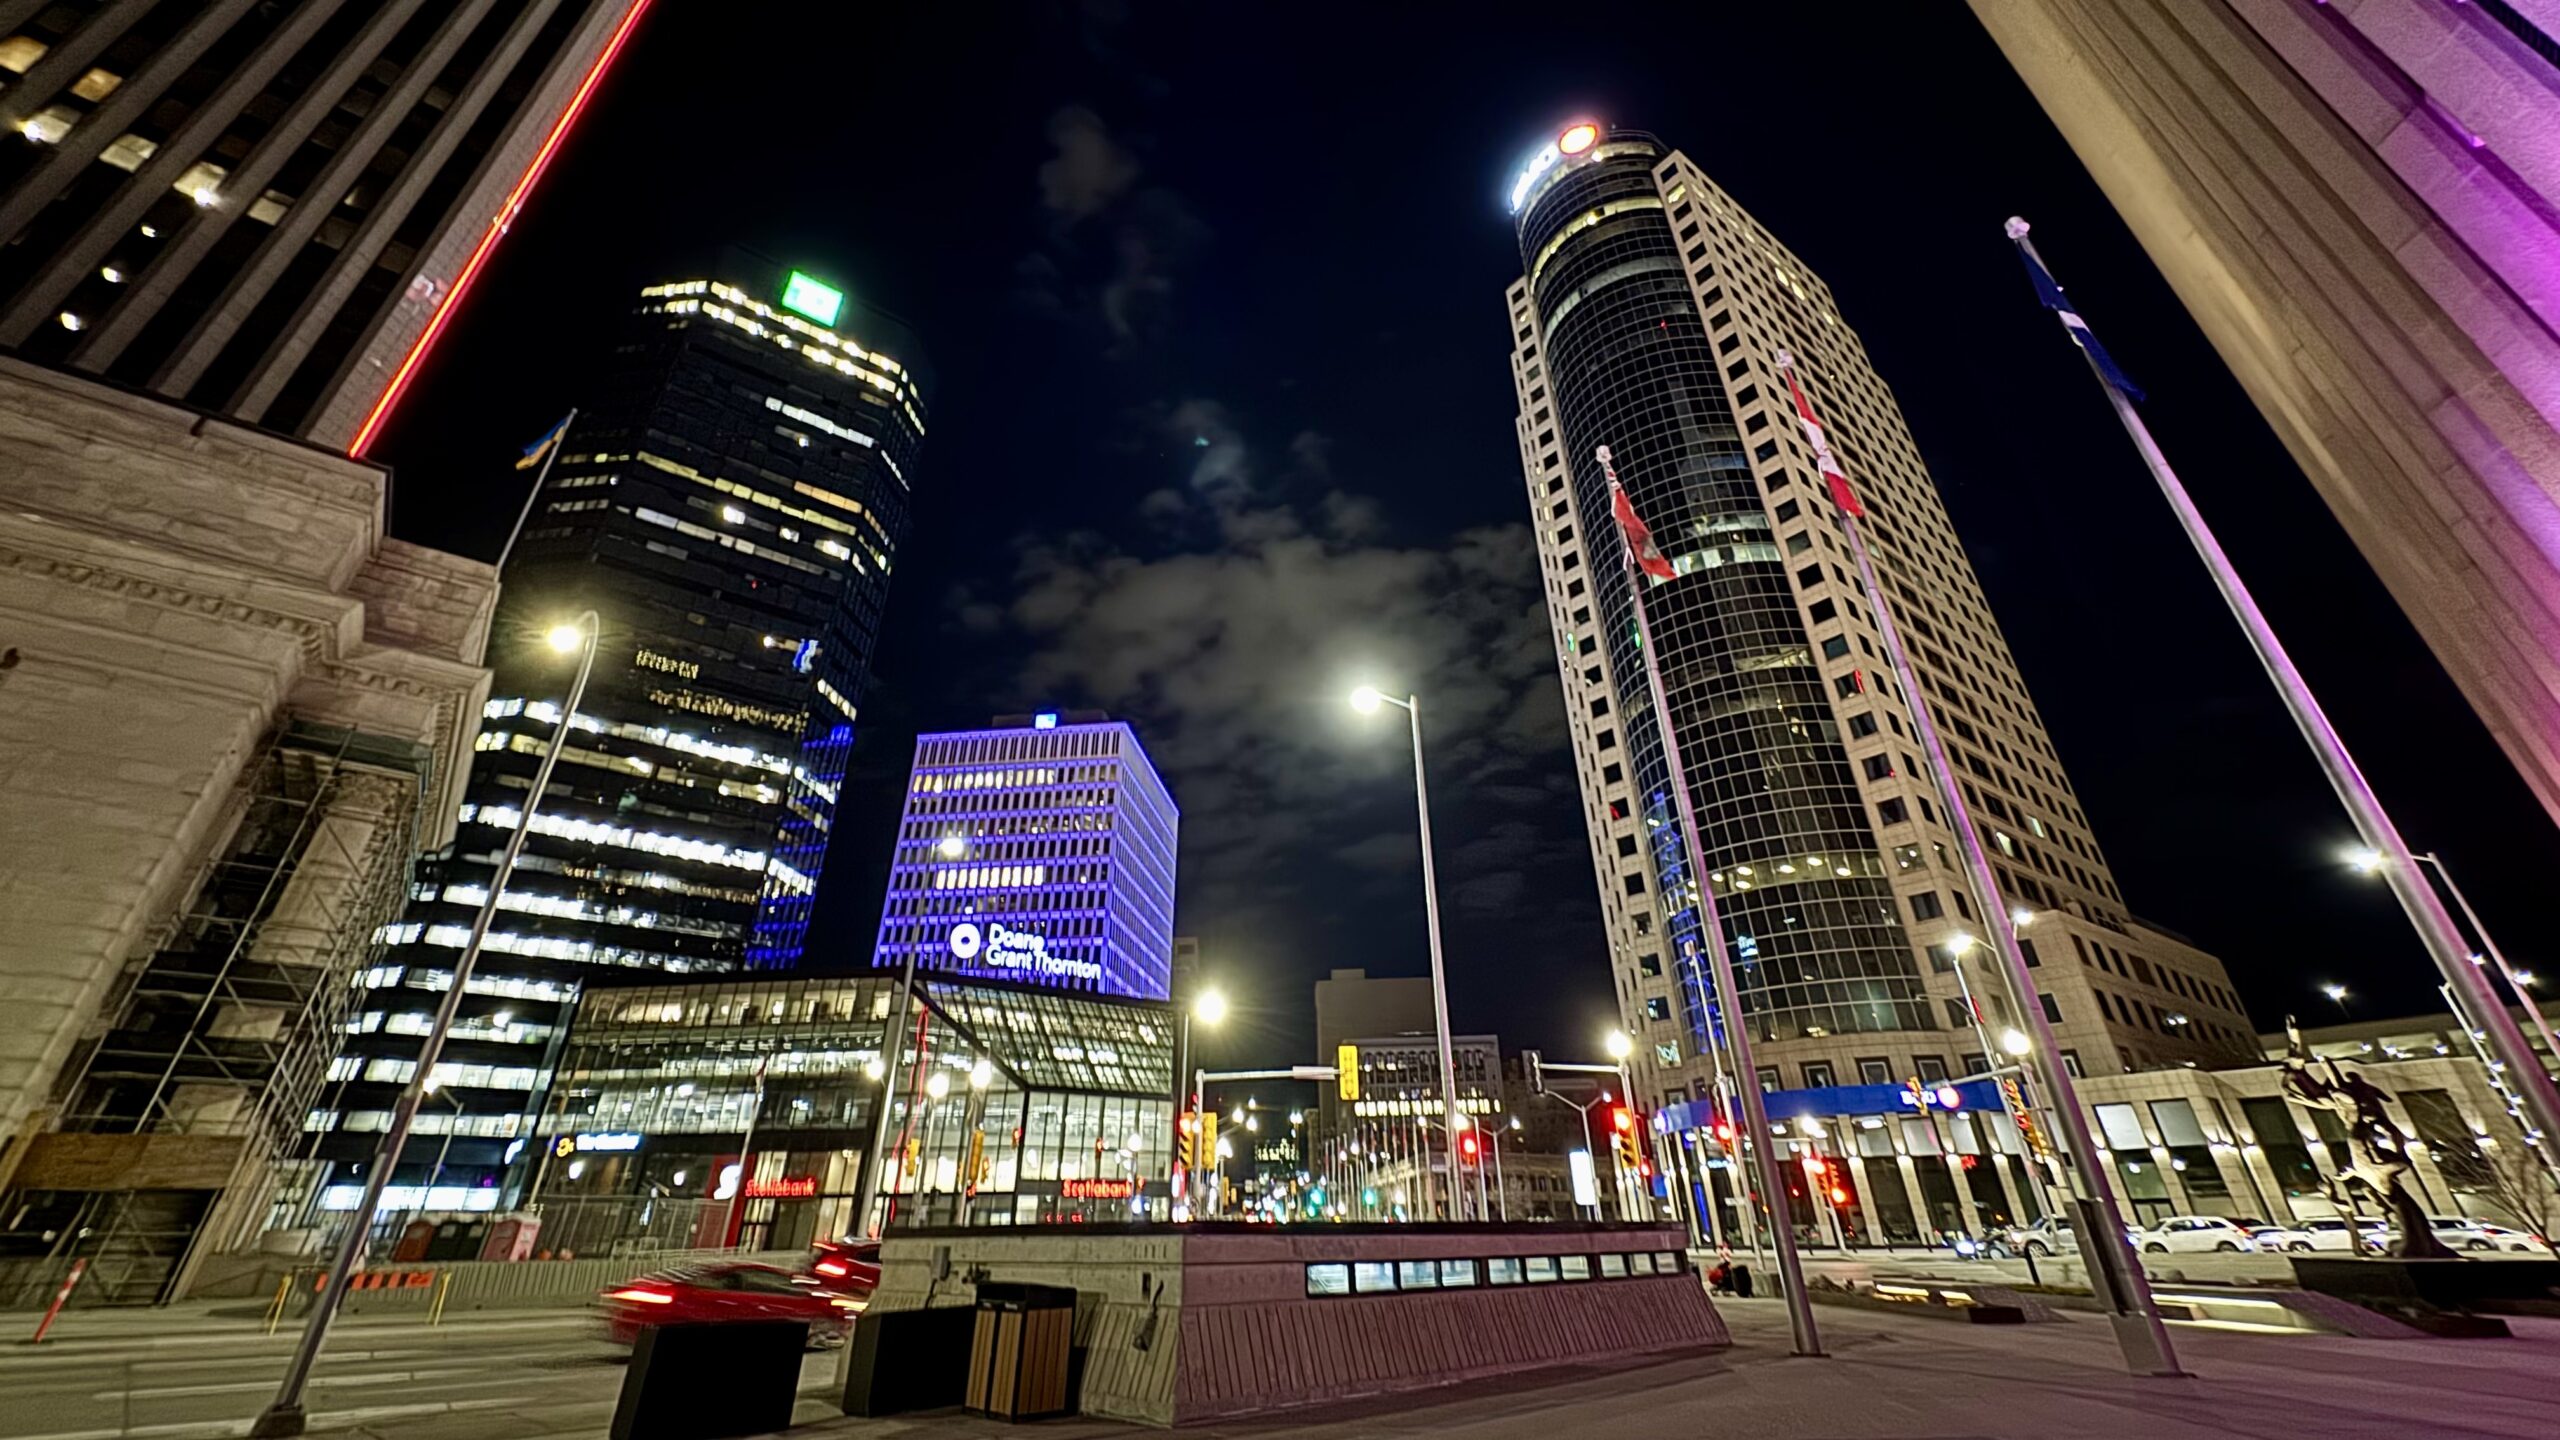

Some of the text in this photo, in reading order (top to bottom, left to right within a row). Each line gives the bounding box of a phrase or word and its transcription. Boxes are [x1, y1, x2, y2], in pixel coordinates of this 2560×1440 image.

[988, 922, 1045, 951] Doane
[986, 944, 1102, 980] Grant Thornton
[1062, 1179, 1133, 1198] Scotiabank
